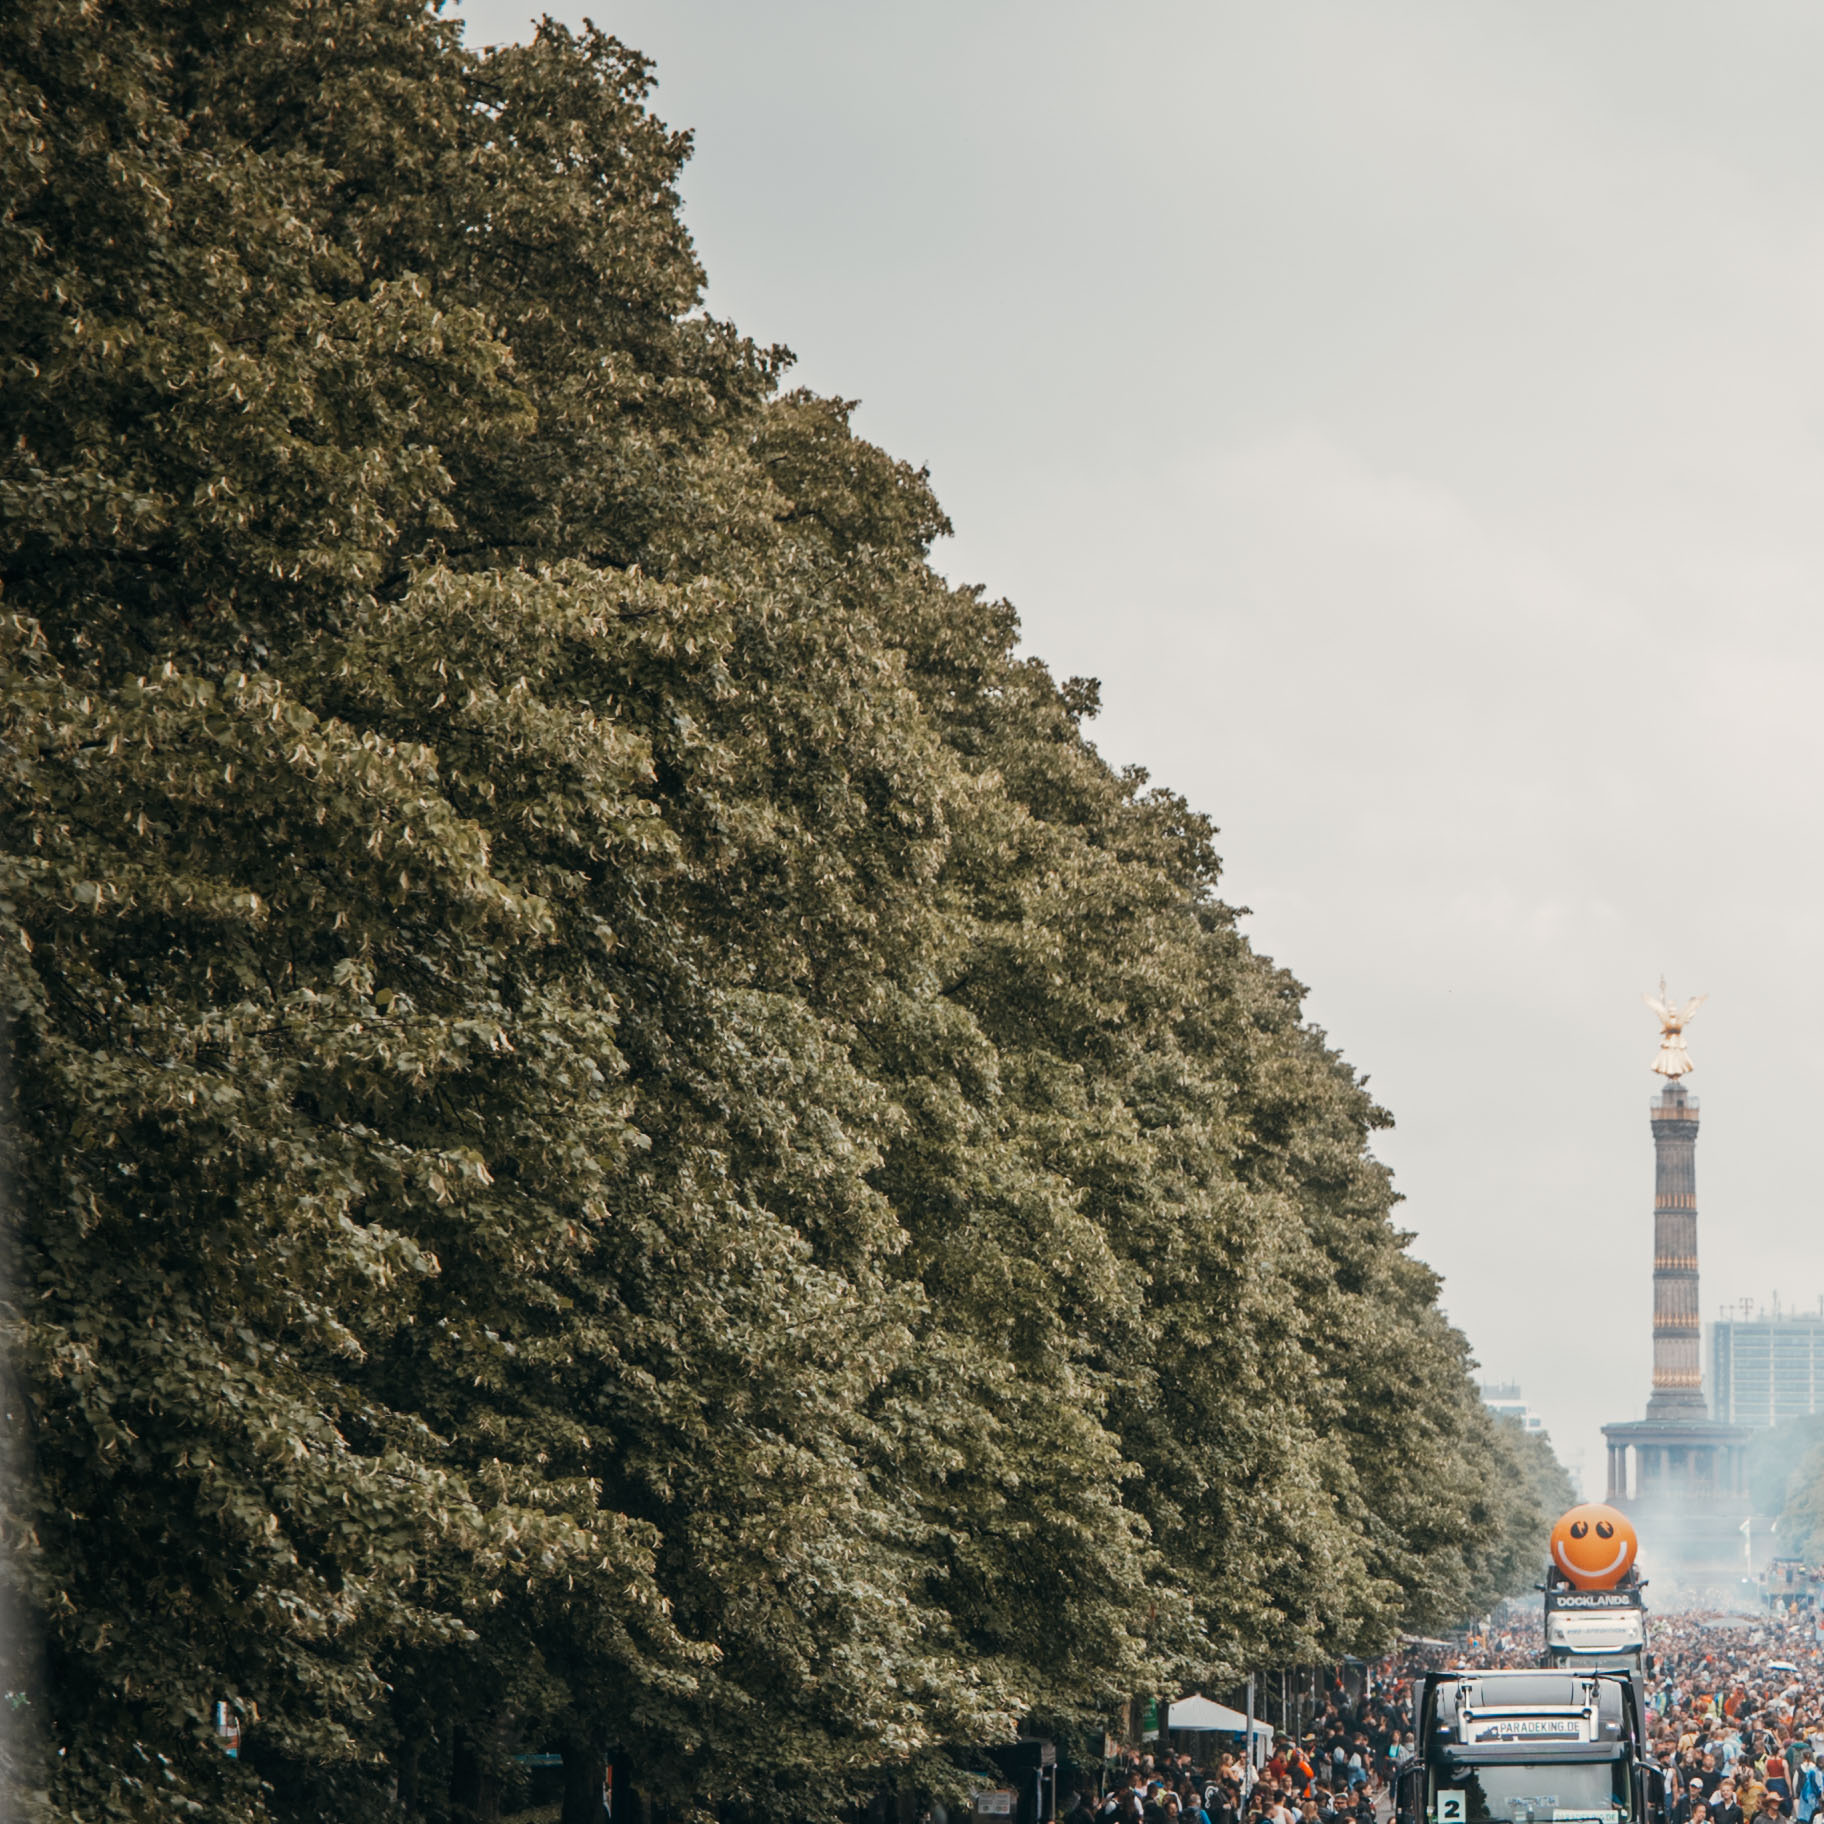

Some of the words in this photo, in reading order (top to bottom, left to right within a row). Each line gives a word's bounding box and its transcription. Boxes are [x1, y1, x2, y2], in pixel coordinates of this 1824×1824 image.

[1557, 1595, 1630, 1608] DOCKLANDS
[1500, 1721, 1580, 1733] PARADEKING.DE
[1444, 1801, 1460, 1820] 2
